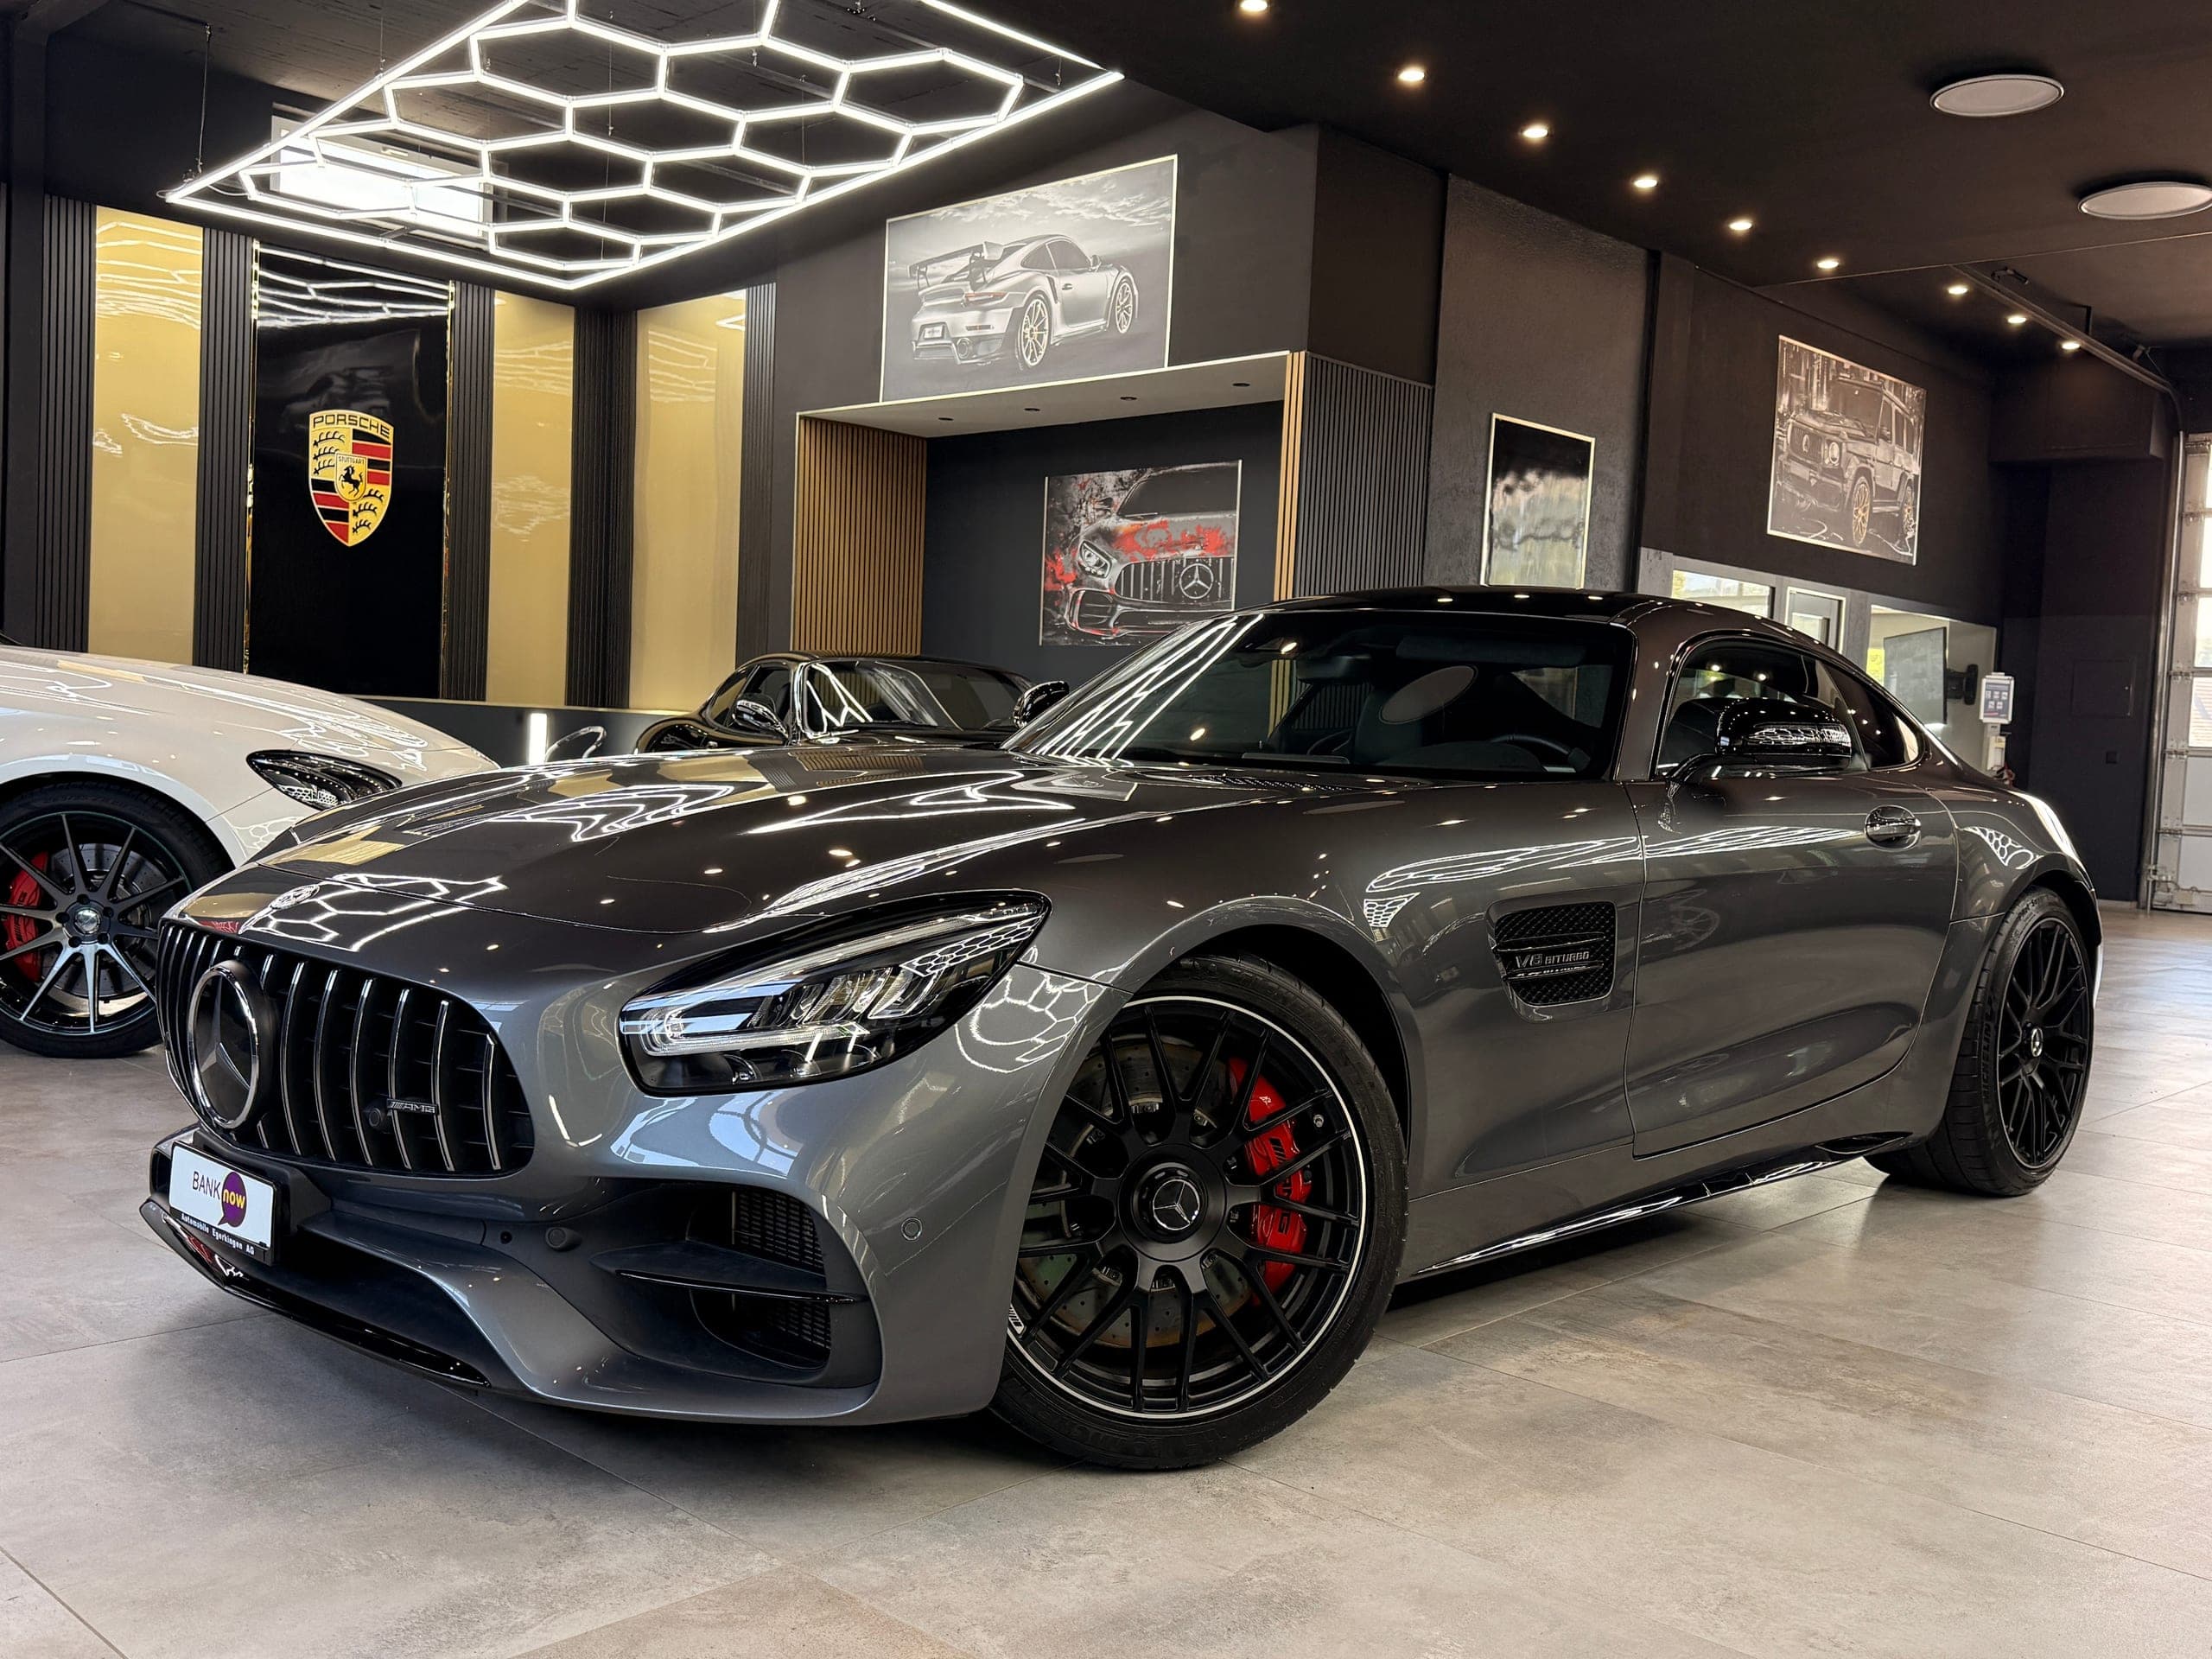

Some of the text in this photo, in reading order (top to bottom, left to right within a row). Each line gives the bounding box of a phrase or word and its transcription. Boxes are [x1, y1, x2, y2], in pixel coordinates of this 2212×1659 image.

[313, 413, 391, 438] PORSCHE
[1516, 951, 1590, 968] V8 BITURBO
[401, 1102, 435, 1114] AMG
[192, 1171, 246, 1209] BANK now
[181, 1213, 209, 1233] Automobile
[245, 1244, 255, 1255] AG
